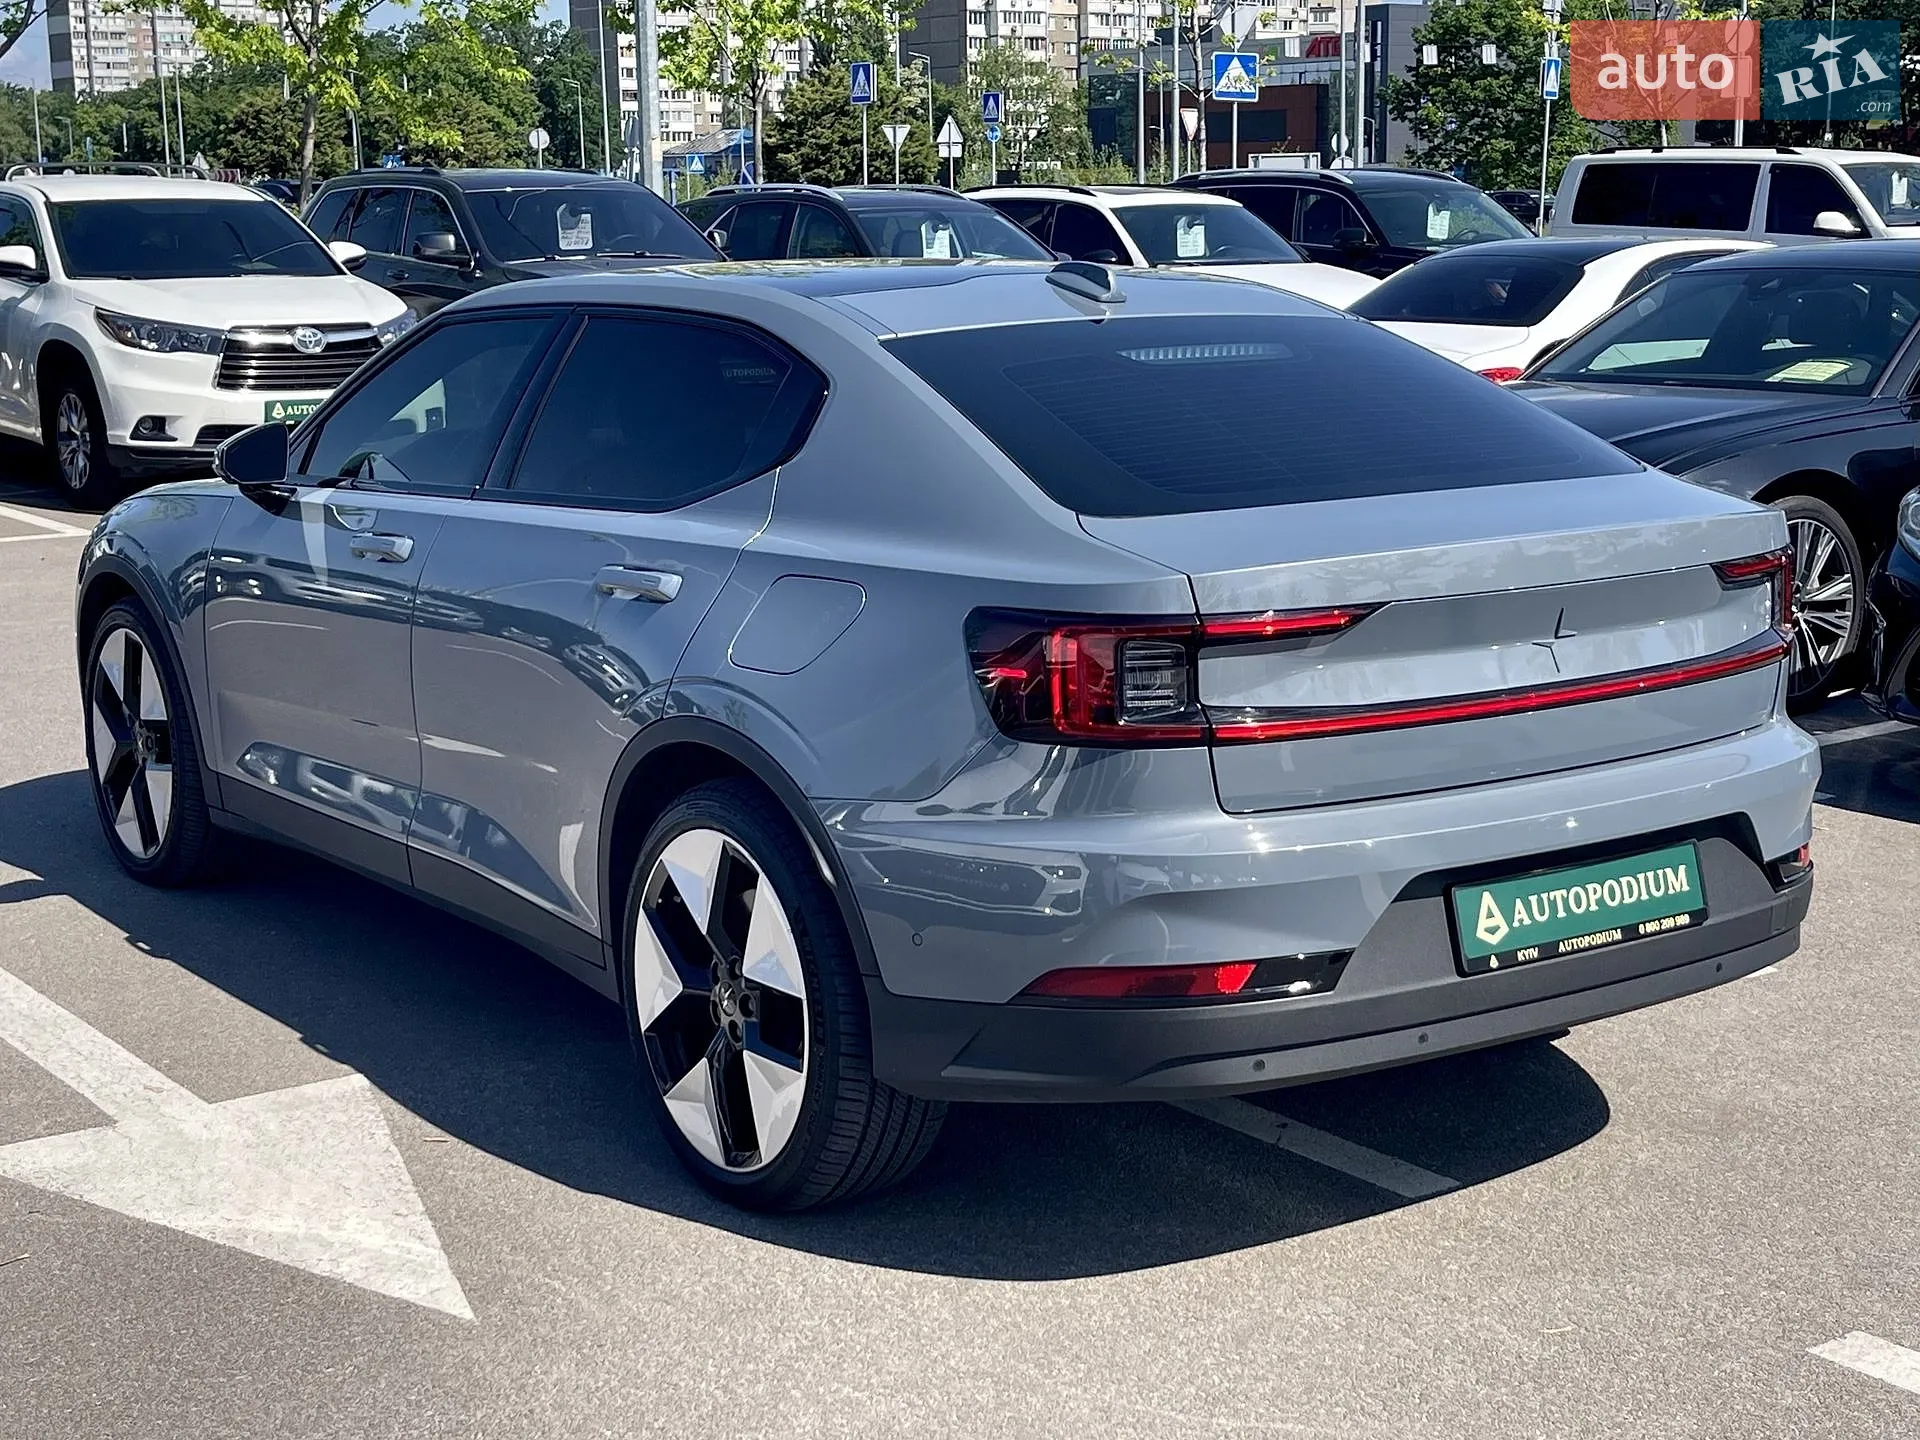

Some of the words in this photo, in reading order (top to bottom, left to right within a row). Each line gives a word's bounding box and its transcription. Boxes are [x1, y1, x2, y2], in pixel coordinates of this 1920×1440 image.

[286, 404, 319, 415] AUTO
[1512, 864, 1690, 927] AUTOPODIUM
[1517, 946, 1539, 962] KYIV
[1558, 929, 1623, 953] AUTOPODIUM
[1638, 923, 1645, 935] 0
